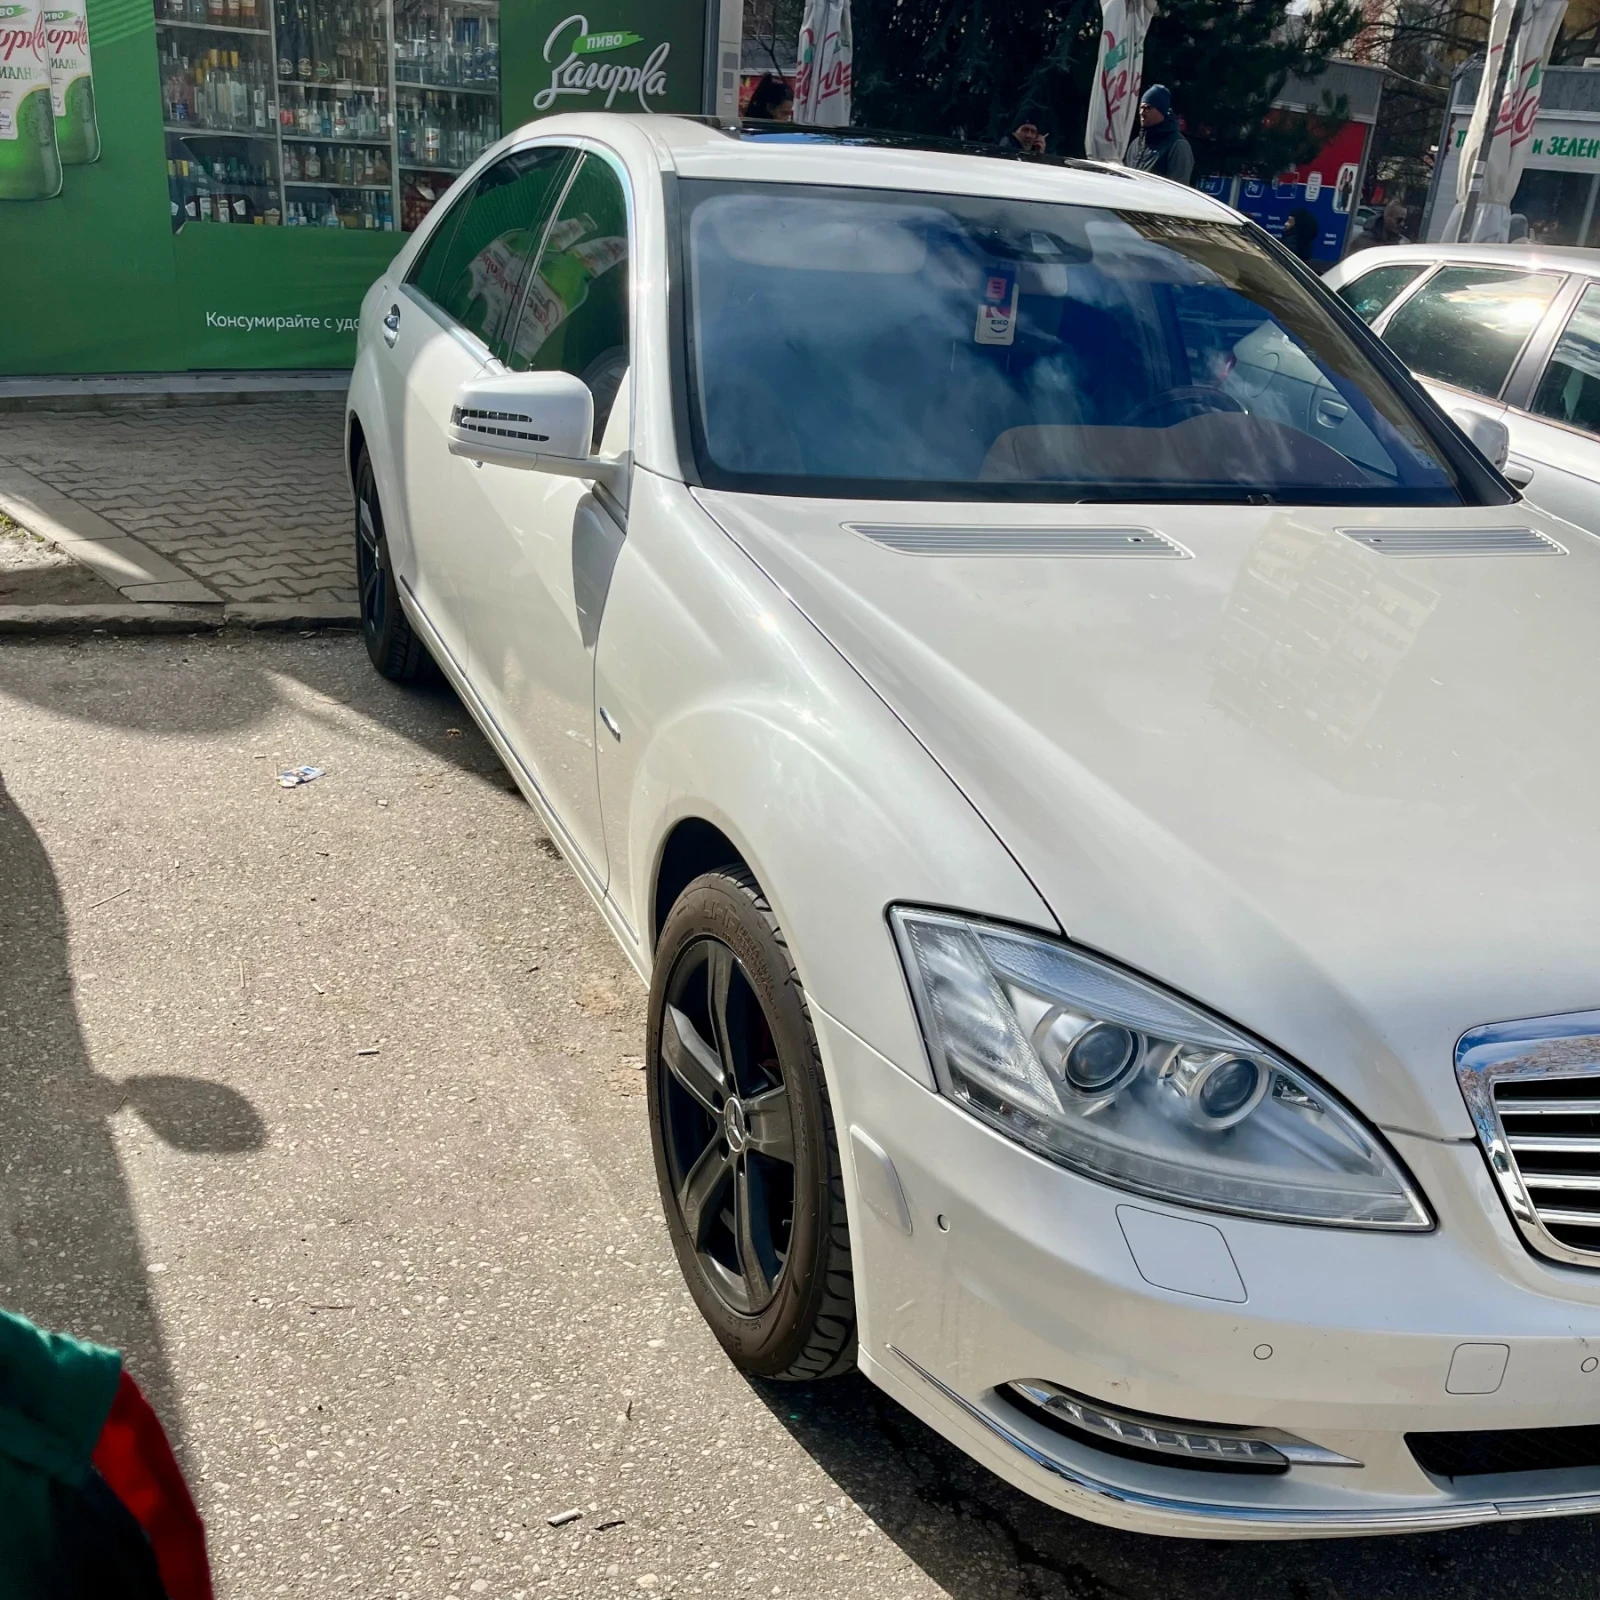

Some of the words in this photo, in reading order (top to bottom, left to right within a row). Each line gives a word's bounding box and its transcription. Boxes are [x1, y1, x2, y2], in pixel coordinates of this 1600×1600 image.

[586, 33, 624, 50] ПИВО
[533, 14, 671, 114] Загорка
[1547, 136, 1600, 159] ЗЕЛЕН
[206, 311, 320, 332] Консумирайте
[323, 318, 332, 328] с
